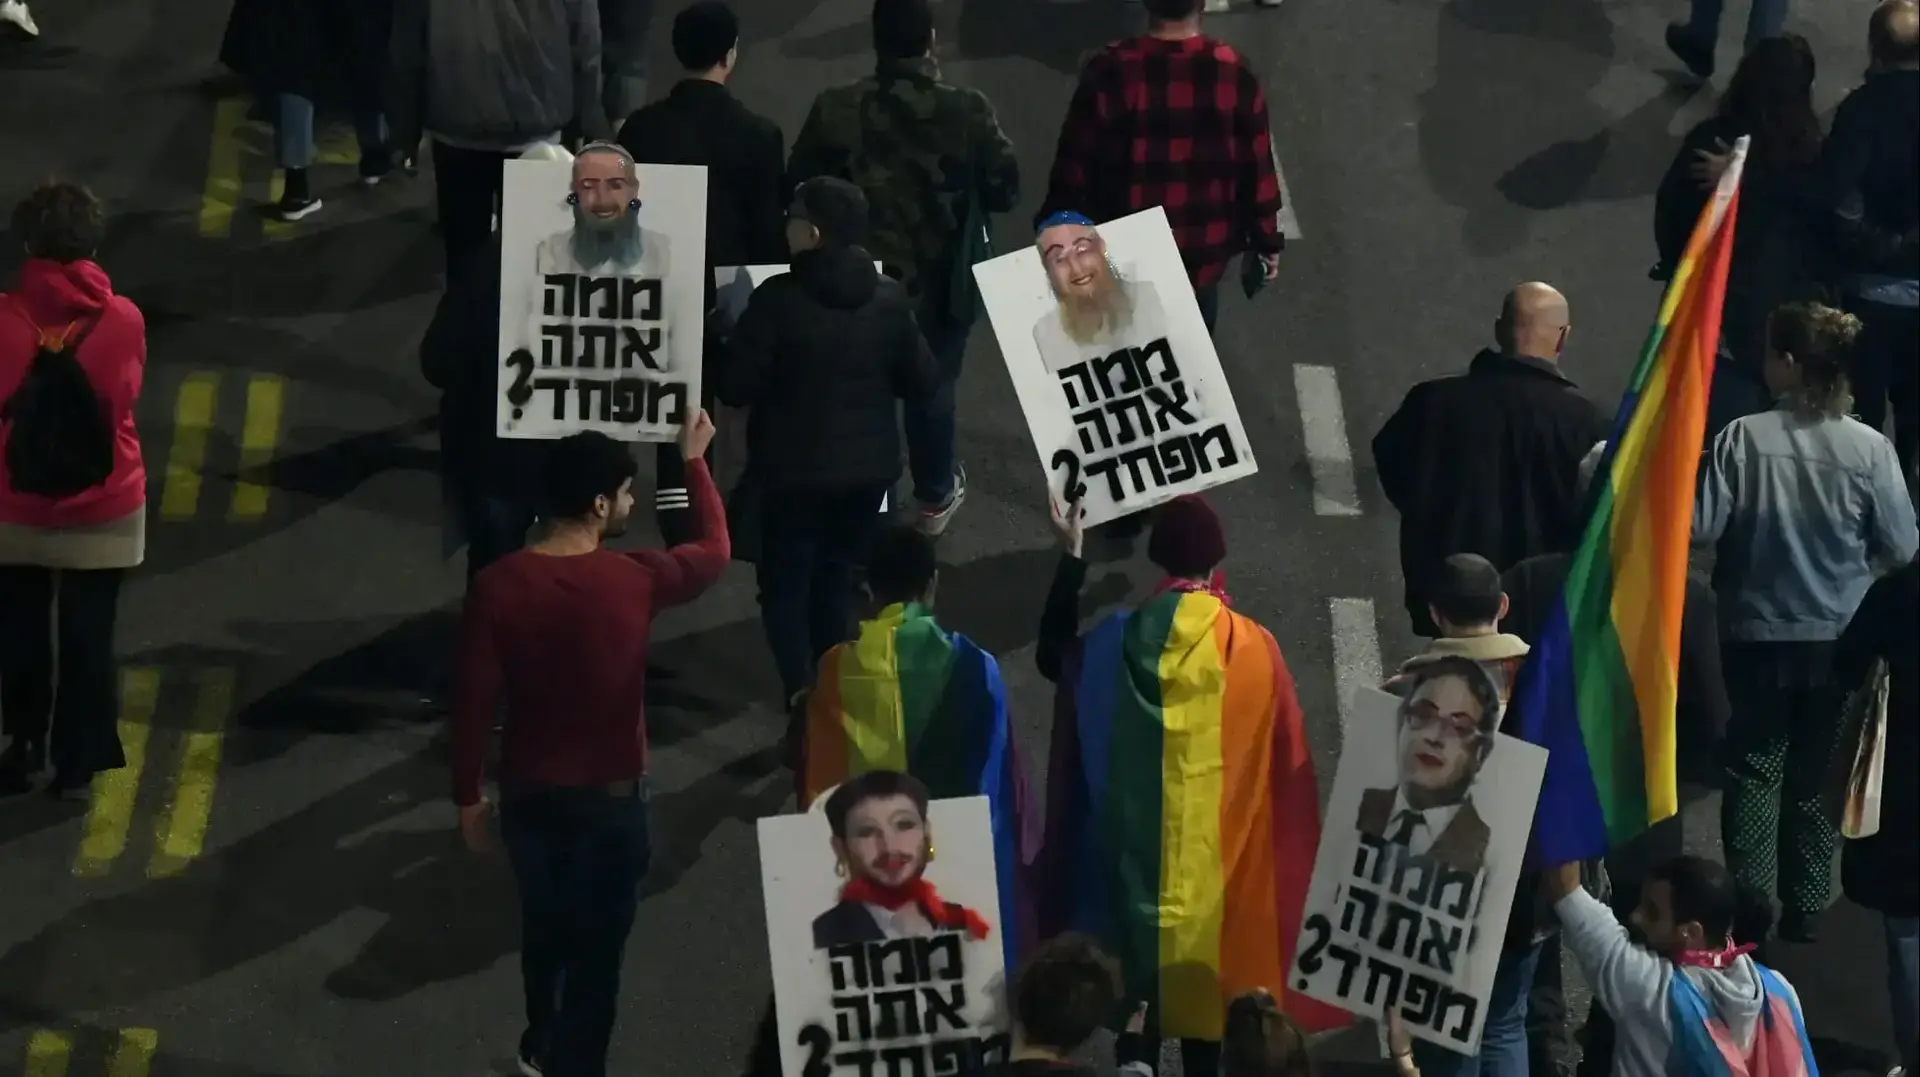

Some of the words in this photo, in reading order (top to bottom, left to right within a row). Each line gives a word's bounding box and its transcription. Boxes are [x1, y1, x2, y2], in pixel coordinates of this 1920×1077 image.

[543, 274, 661, 321] ממה
[541, 325, 664, 371] אתה
[1057, 336, 1180, 409] ממה
[505, 348, 687, 424] מפחד?
[1072, 380, 1197, 454] אתה
[1051, 423, 1238, 519] מפחד?
[1352, 831, 1474, 920] ממה
[828, 933, 963, 990] ממה
[1340, 886, 1462, 974] אתה
[832, 983, 968, 1041] אתה
[1298, 914, 1478, 1043] מפחד?
